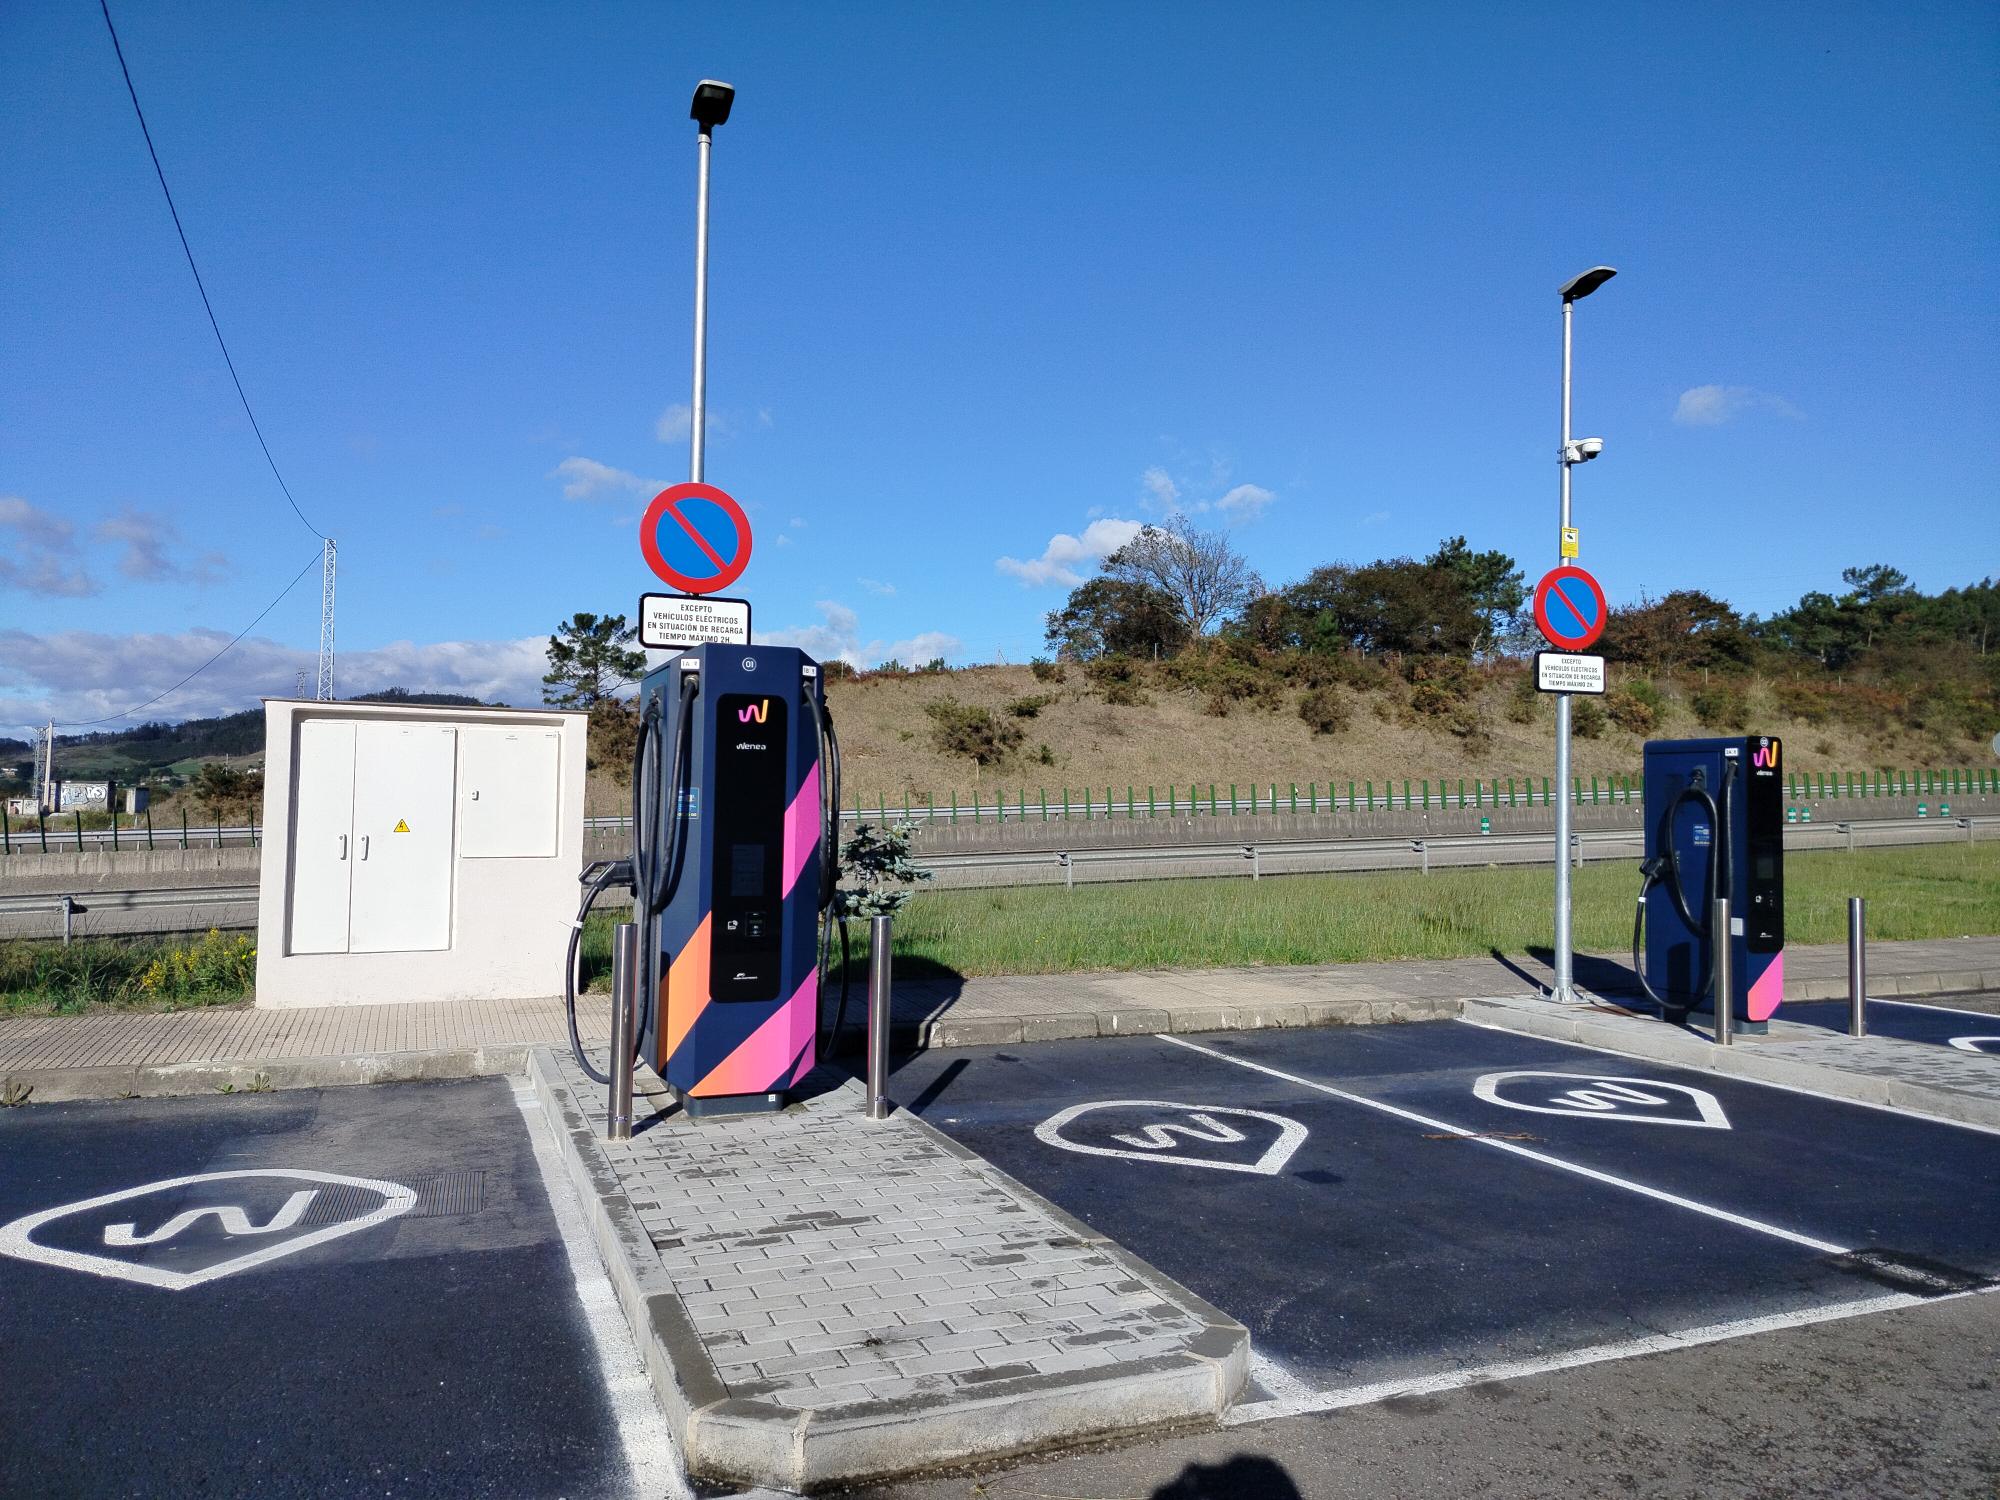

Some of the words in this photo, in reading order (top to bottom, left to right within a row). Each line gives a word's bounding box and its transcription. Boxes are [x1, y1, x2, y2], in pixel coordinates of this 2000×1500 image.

[680, 604, 713, 613] EXCEPTO
[699, 625, 709, 633] DE
[711, 626, 744, 635] RECARGA
[659, 632, 687, 641] TIEMPO
